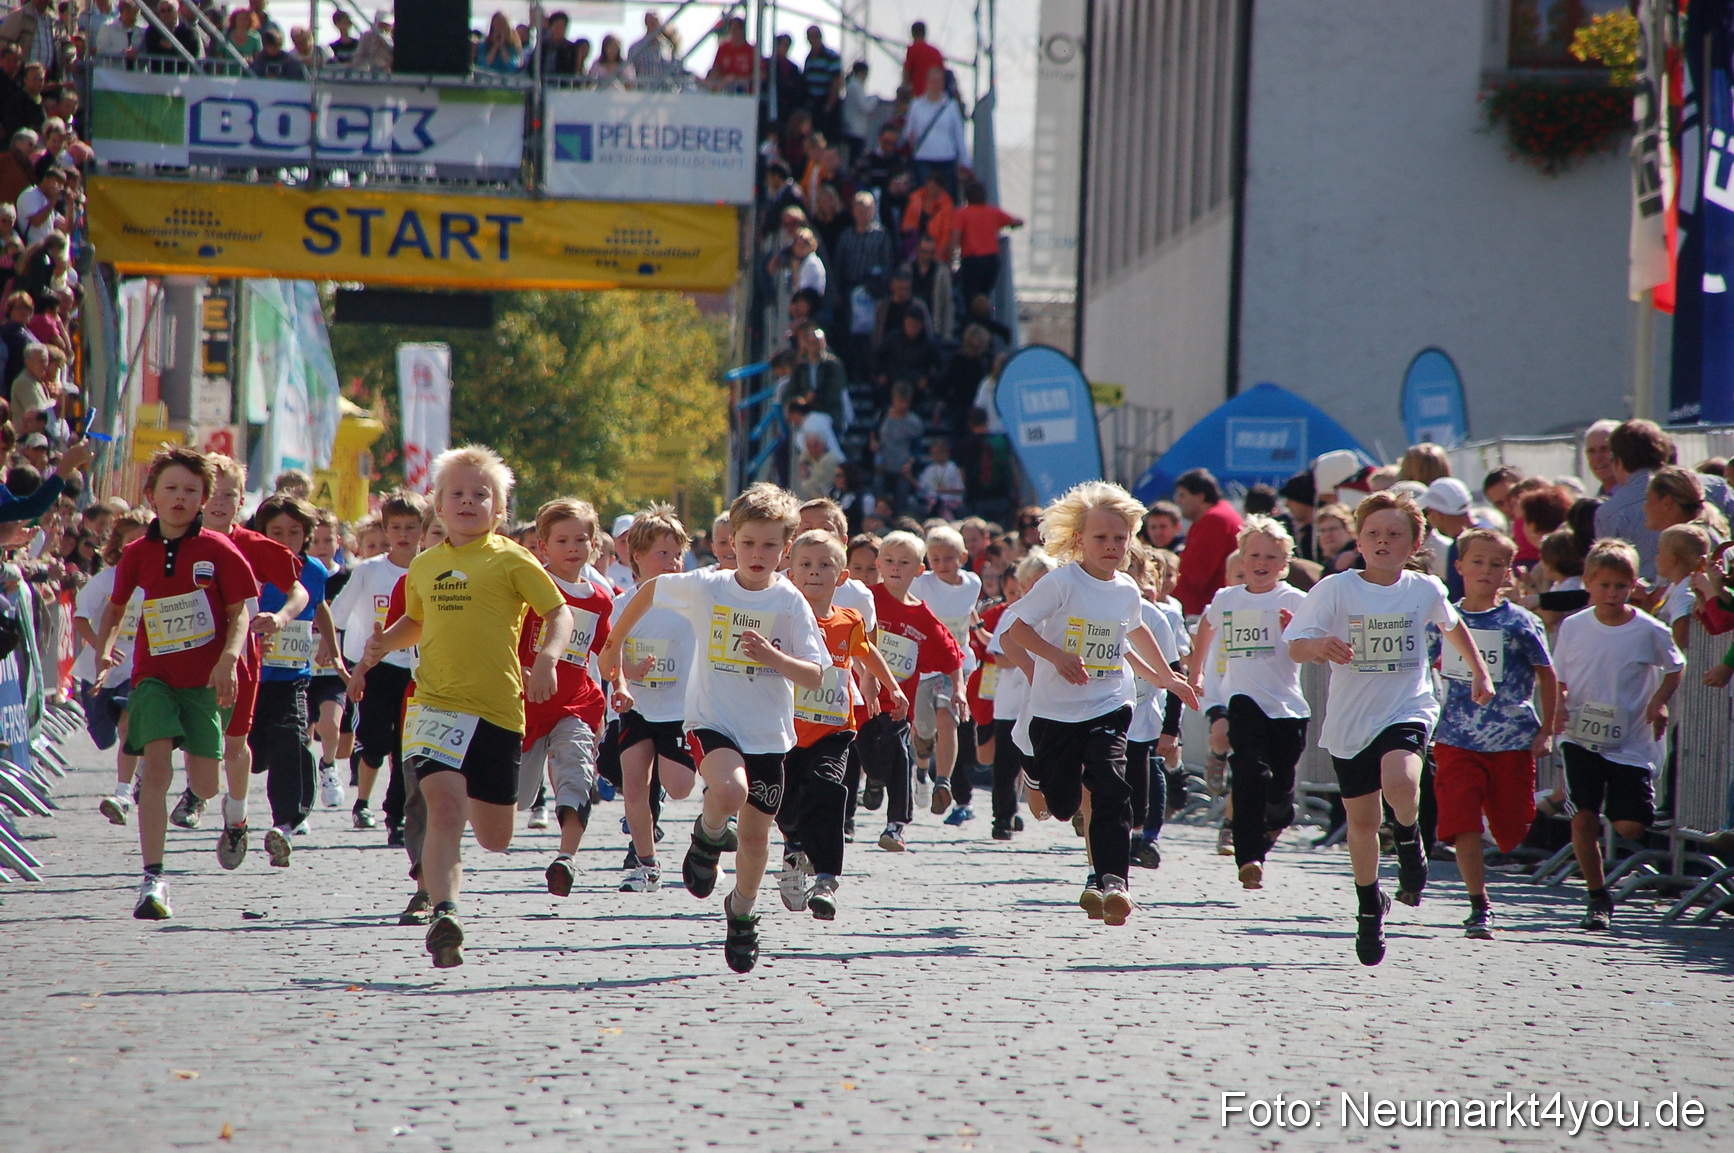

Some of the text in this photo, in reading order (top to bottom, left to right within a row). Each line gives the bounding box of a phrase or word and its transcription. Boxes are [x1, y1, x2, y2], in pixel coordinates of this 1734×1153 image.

[190, 97, 436, 154] BOCK
[598, 122, 744, 153] PFLEIDERER
[204, 229, 264, 242] Stadtlauf
[303, 206, 524, 262] START
[433, 581, 468, 591] skinfit
[160, 598, 199, 613] Jonathan
[438, 594, 472, 602] Hilpoltstein
[163, 611, 208, 635] 7278
[732, 612, 761, 628] Kilian
[1368, 617, 1414, 630] Alexander
[282, 625, 301, 633] David
[713, 629, 723, 640] K4
[1087, 623, 1111, 637] Tizian
[1235, 627, 1269, 642] 7301
[282, 638, 310, 653] 7006
[569, 629, 591, 647] 094
[732, 633, 782, 652] 76
[883, 635, 900, 648] Elias
[1067, 638, 1077, 648] K4
[1370, 634, 1415, 654] 7015
[636, 642, 655, 653] Elias
[1086, 642, 1121, 660] 7084
[831, 652, 847, 663] heck
[881, 649, 913, 670] 7276
[637, 658, 676, 673] 50
[755, 666, 780, 674] PFLEIDE
[415, 719, 465, 747] 7273
[1581, 719, 1622, 739] 7016
[748, 780, 781, 807] 20
